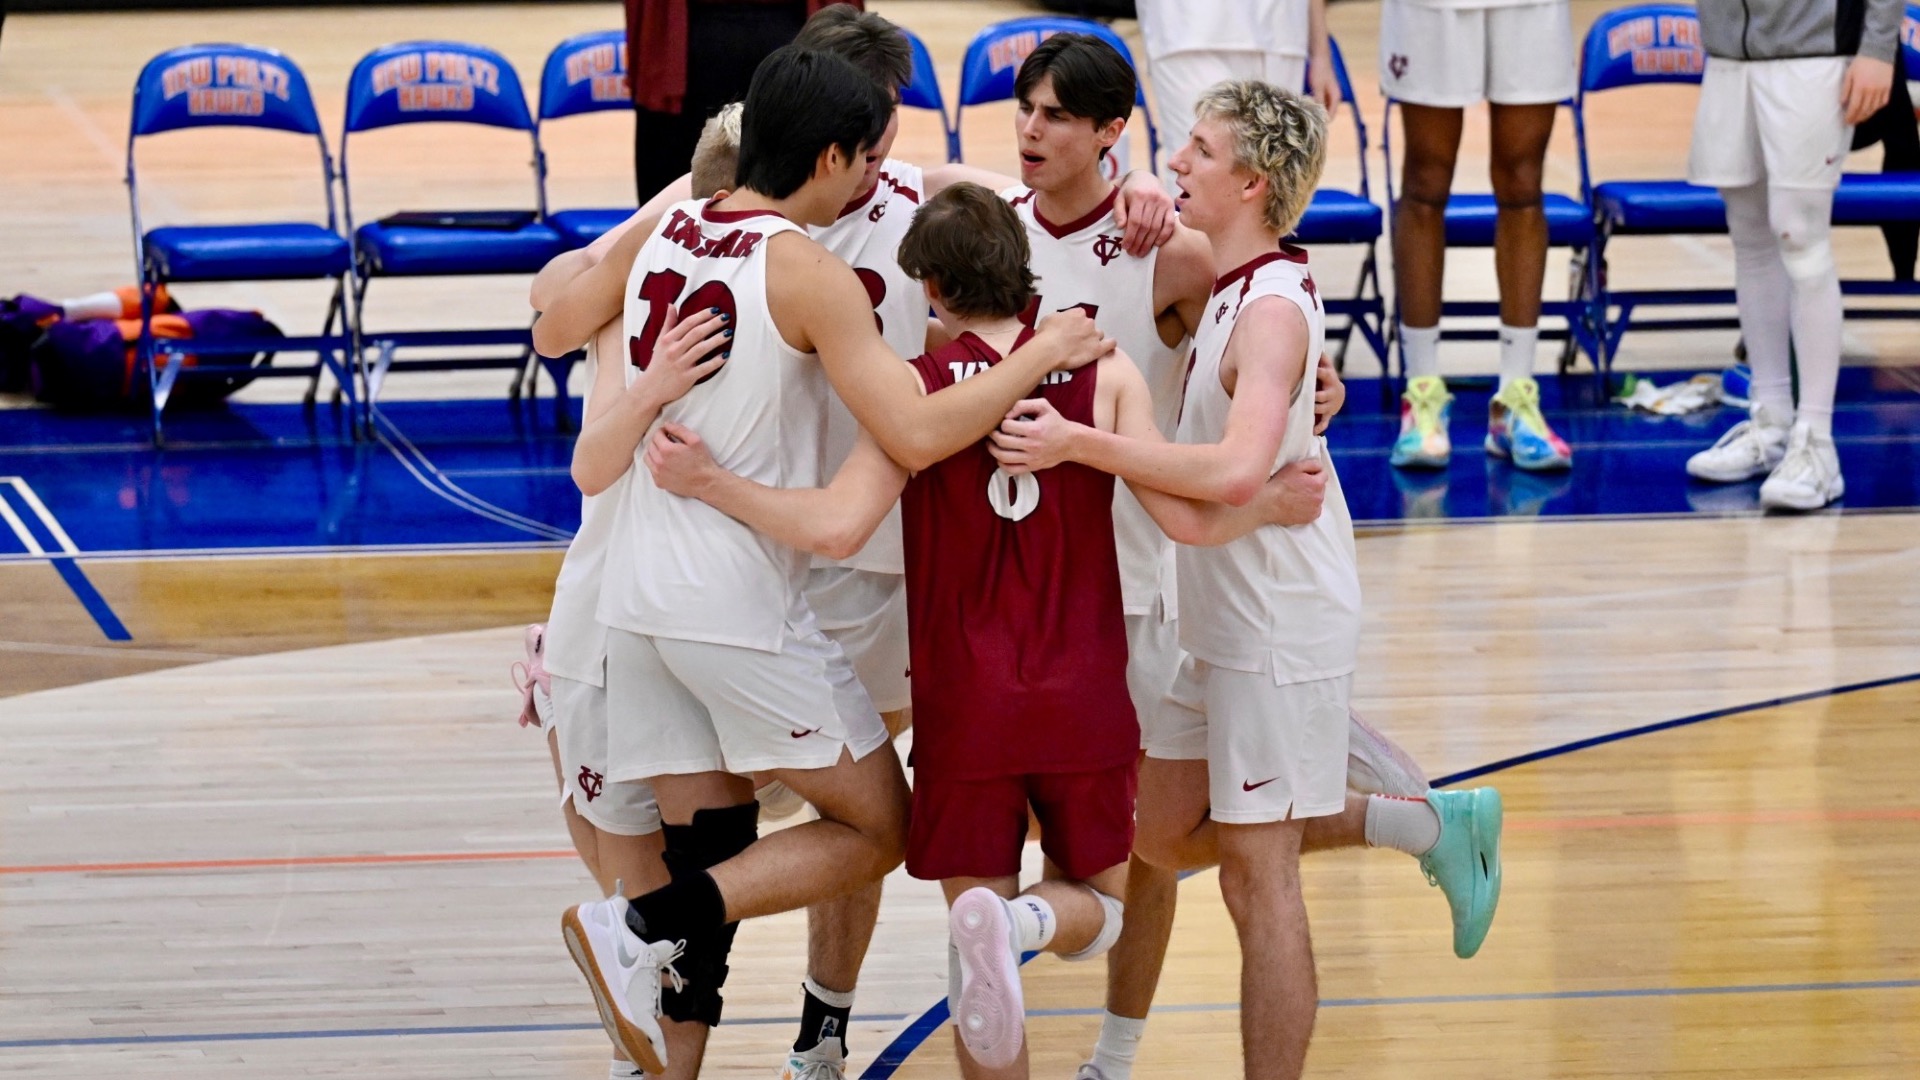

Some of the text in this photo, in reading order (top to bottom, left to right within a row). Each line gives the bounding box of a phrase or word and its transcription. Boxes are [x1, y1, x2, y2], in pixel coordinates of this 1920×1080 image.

[1607, 16, 1654, 60] NEW
[162, 56, 290, 102] NEW PALTZ
[372, 51, 500, 96] NEW PALTZ
[565, 43, 615, 87] NEW
[187, 90, 265, 116] HAWKS
[397, 85, 475, 112] HAWKS
